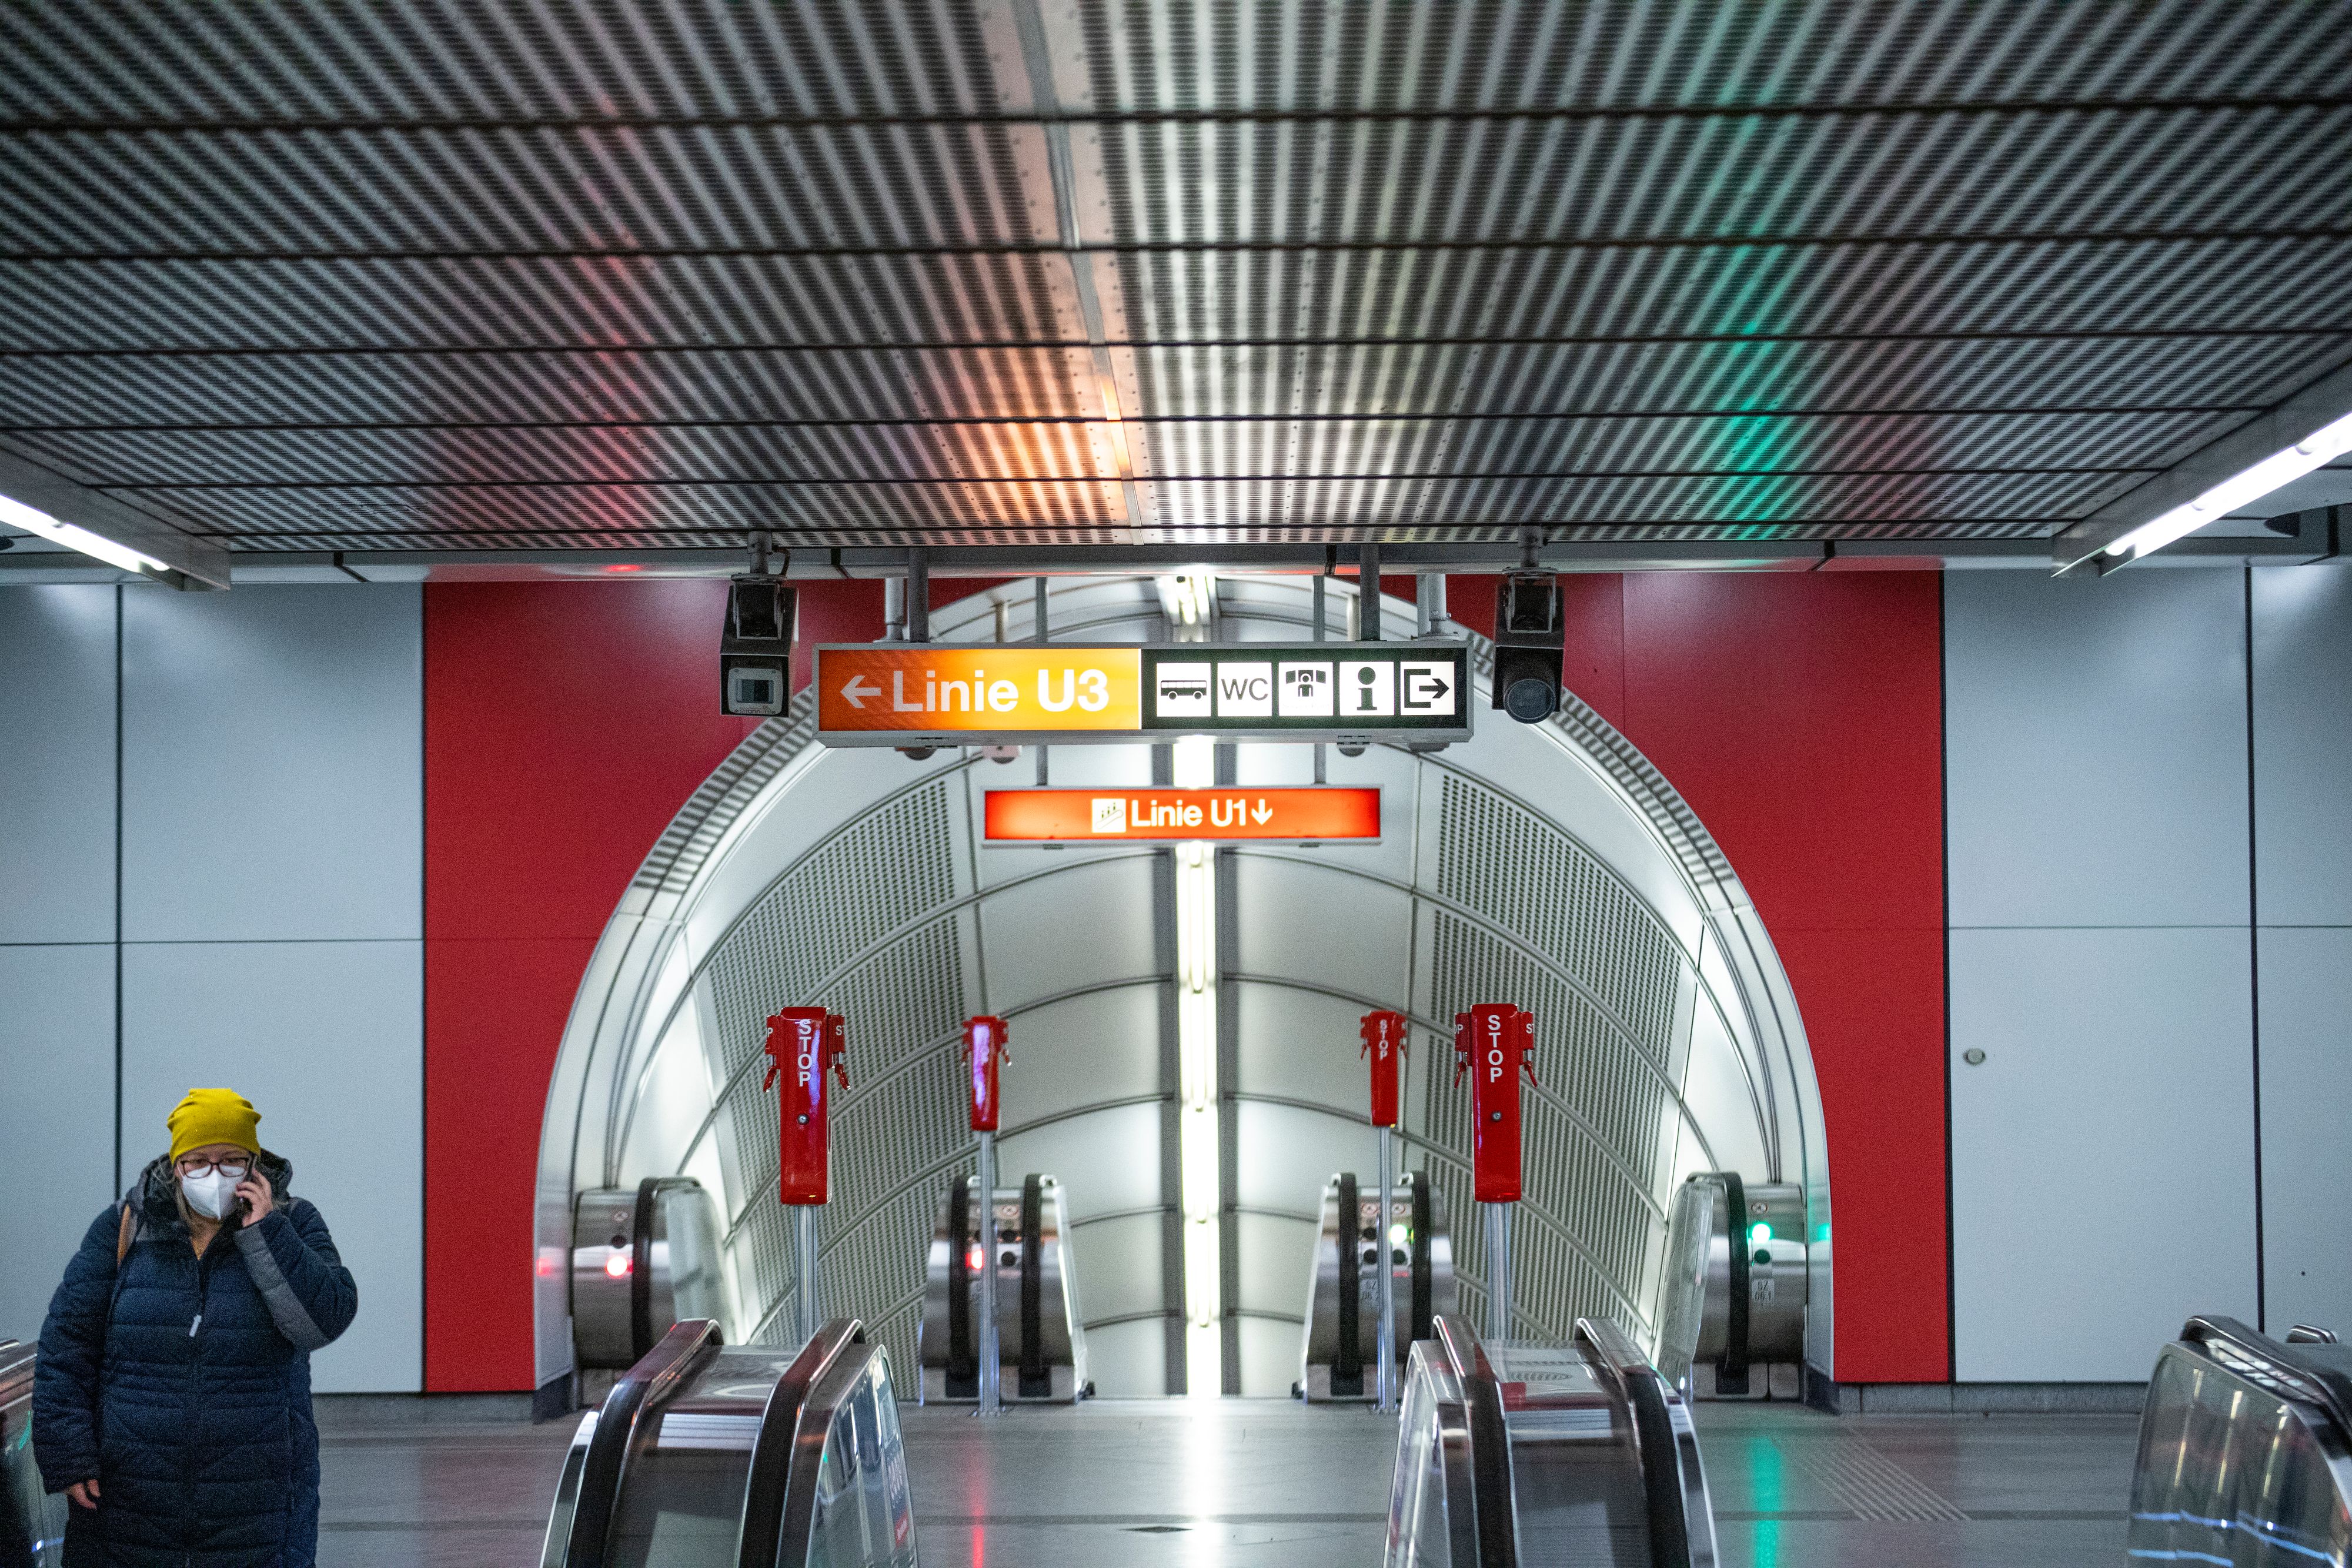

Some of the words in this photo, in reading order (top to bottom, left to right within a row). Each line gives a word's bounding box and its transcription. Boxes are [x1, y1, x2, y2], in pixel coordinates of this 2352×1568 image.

[893, 670, 1019, 712] Linie
[1038, 668, 1110, 712] U3
[1221, 677, 1269, 701] WC
[1131, 800, 1203, 827] Linie
[1211, 799, 1246, 827] U1
[798, 1019, 813, 1087] STOP
[1379, 1019, 1388, 1061] STOP
[1488, 1015, 1504, 1083] STOP
